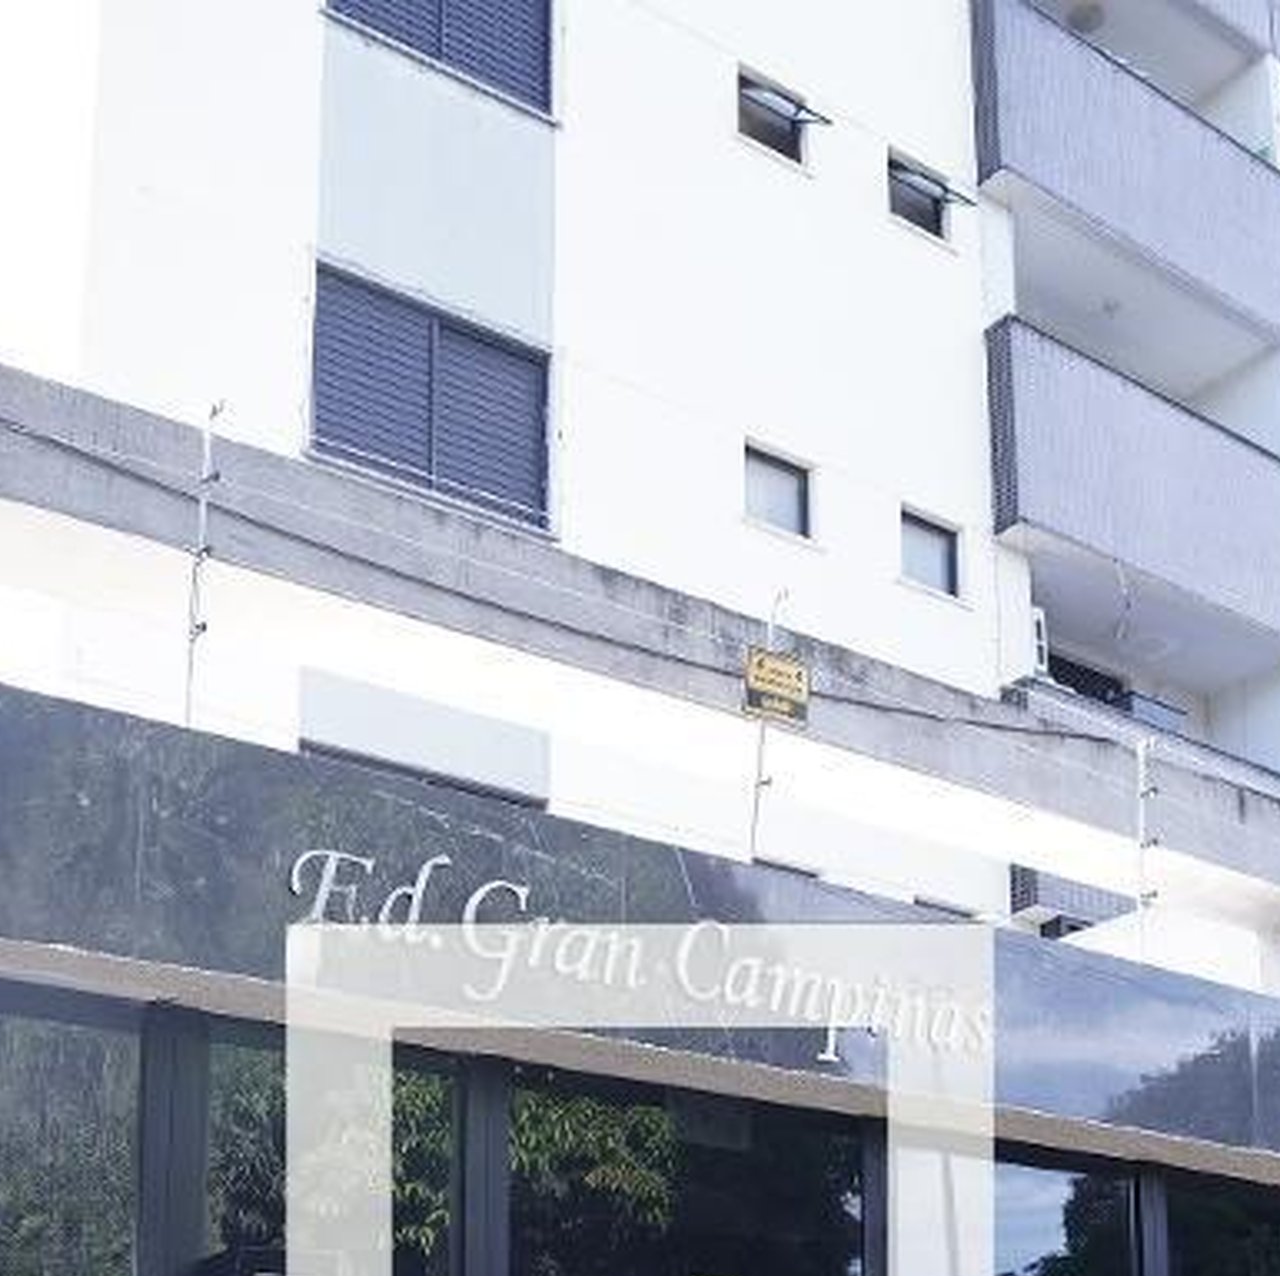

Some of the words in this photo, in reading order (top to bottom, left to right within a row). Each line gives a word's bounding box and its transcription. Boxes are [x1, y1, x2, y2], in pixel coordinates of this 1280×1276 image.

[291, 849, 452, 950] Ed.
[461, 879, 646, 1002] Gran
[676, 919, 990, 1063] Campinas
